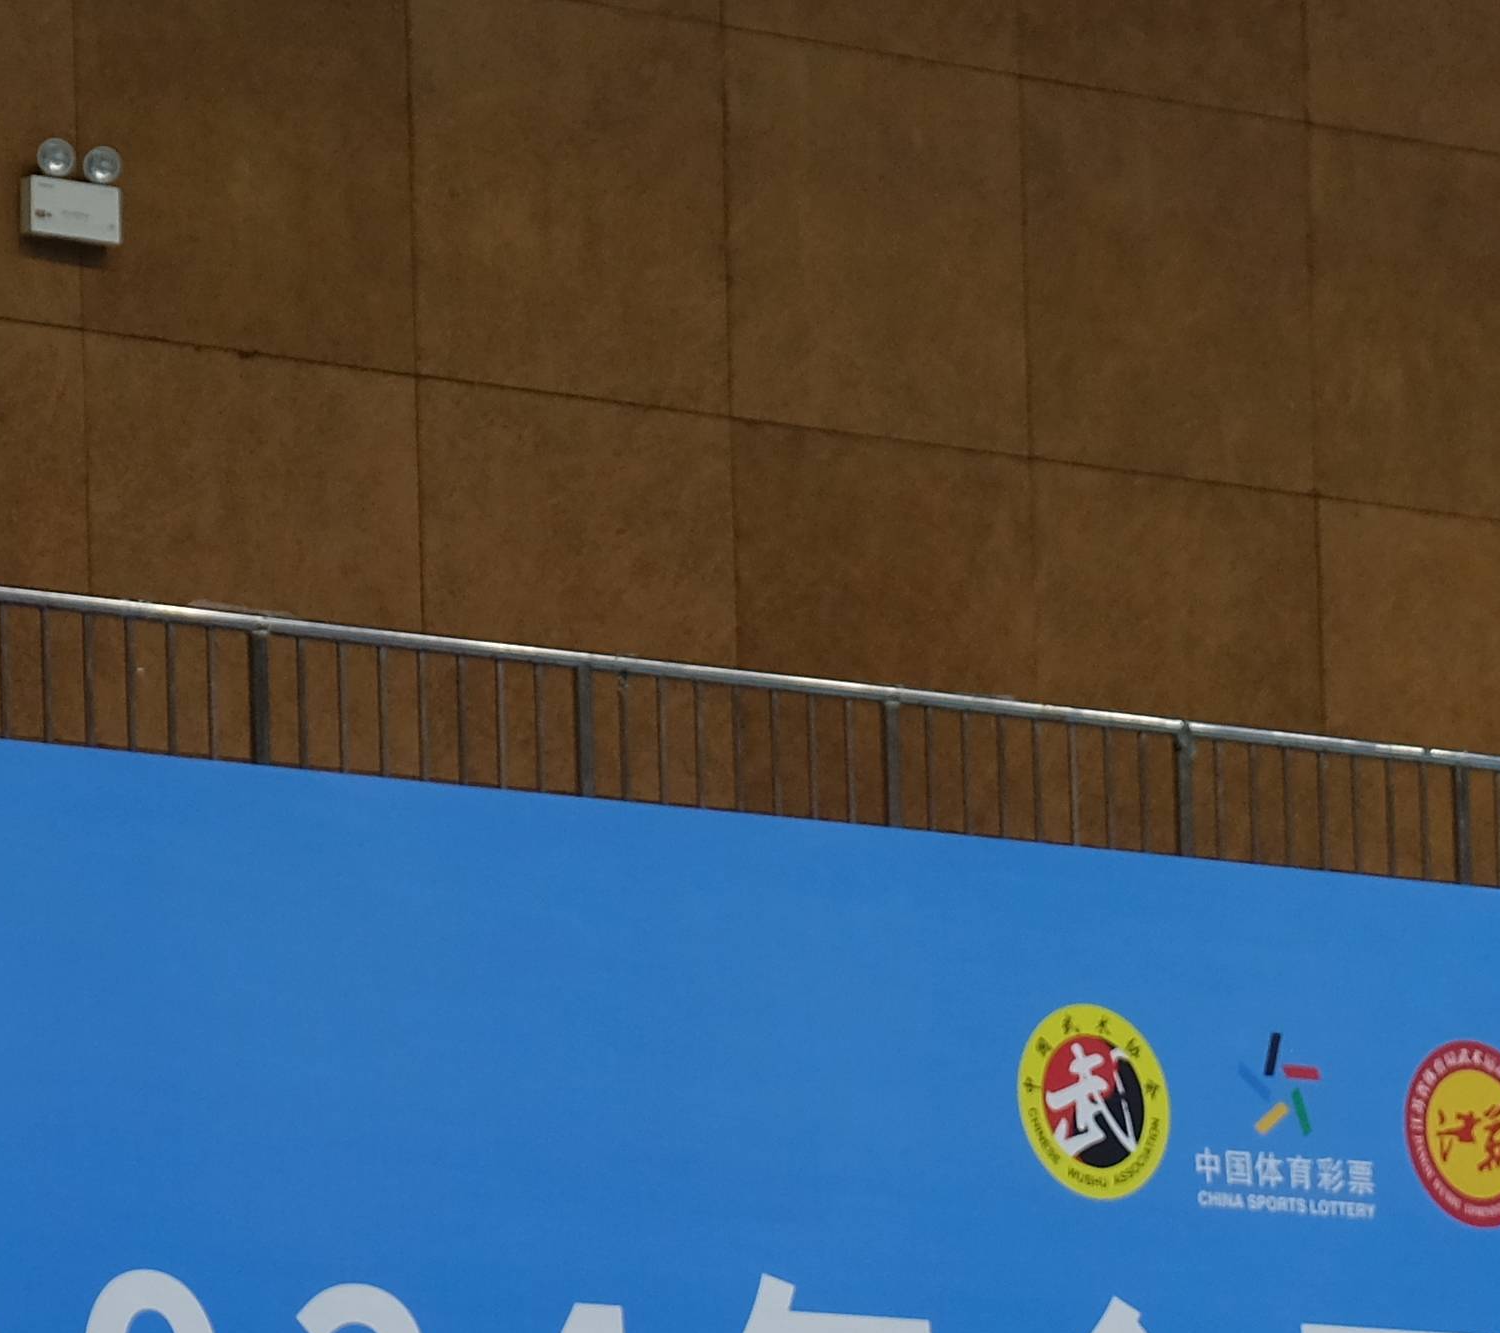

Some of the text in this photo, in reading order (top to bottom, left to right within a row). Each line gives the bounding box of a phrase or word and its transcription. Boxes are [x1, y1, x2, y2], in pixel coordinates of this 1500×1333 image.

[1195, 1147, 1375, 1196] 中国体育彩票
[1197, 1190, 1376, 1219] CHINA SPORTS LOTTERY
